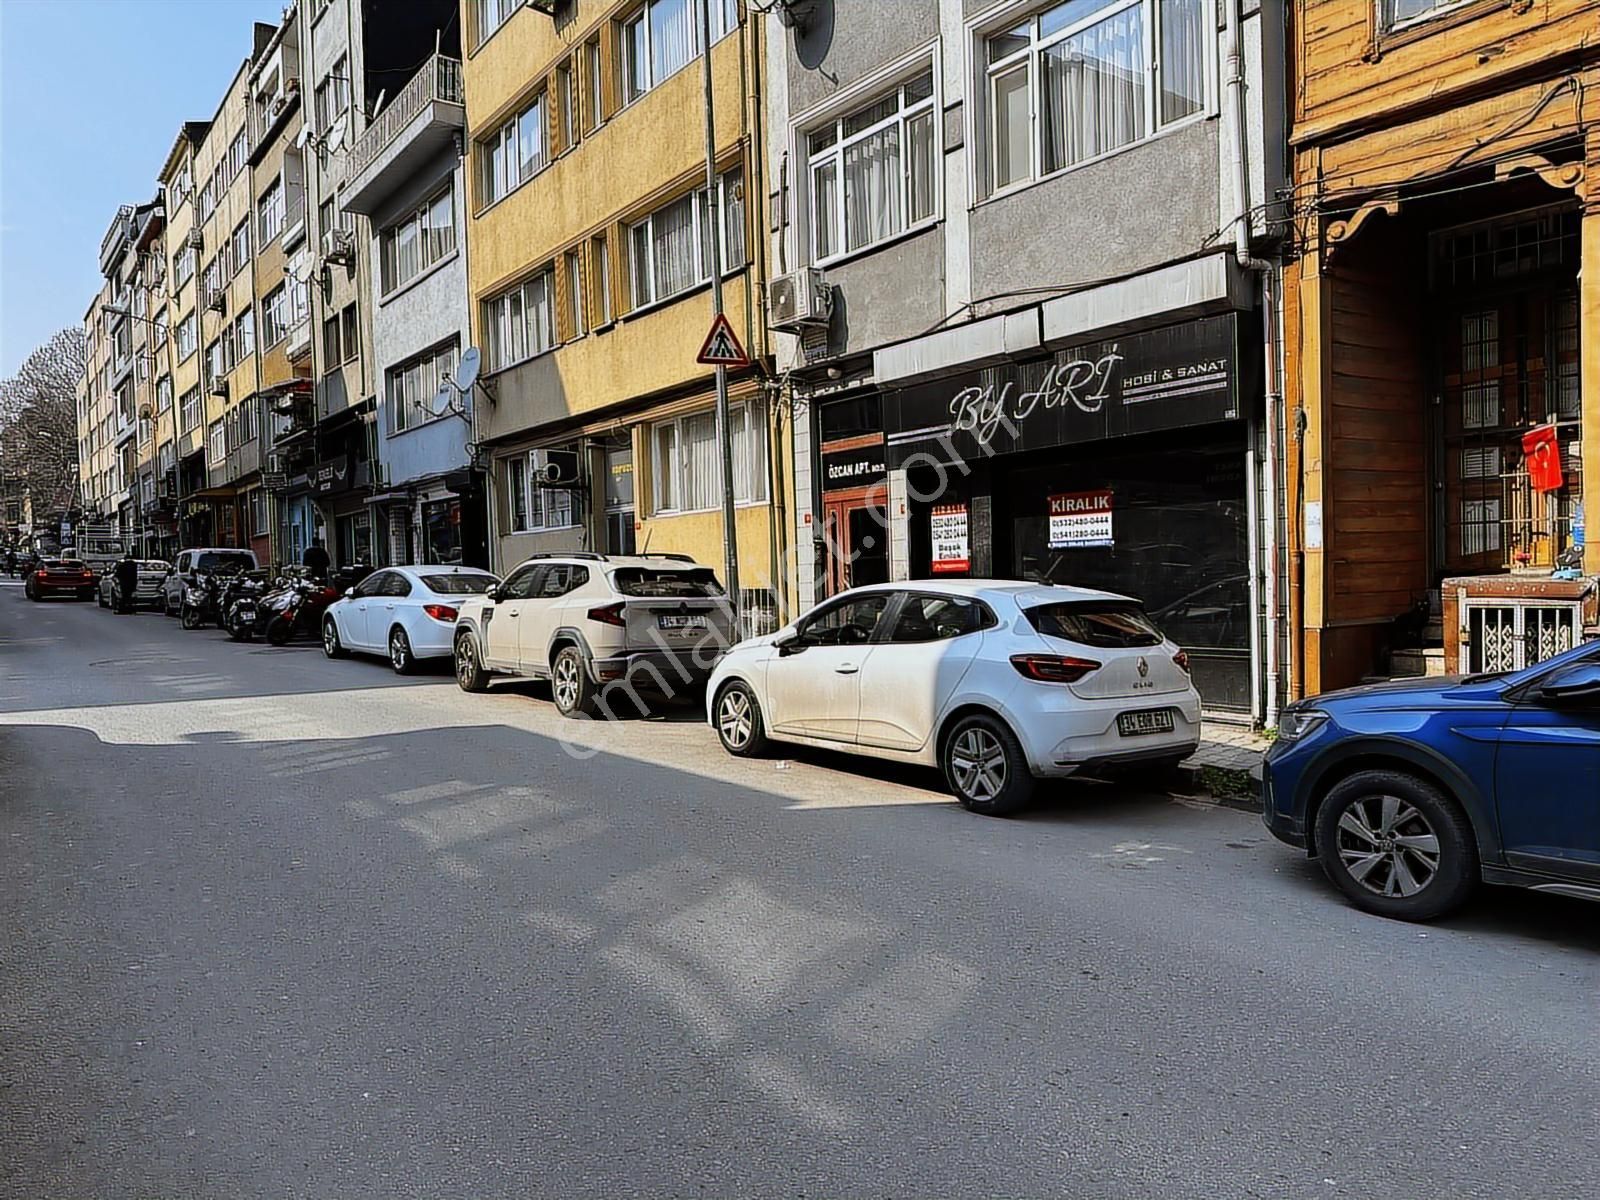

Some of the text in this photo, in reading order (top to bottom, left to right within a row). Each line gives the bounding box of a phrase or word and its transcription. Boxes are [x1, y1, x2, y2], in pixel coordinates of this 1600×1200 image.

[1123, 359, 1228, 388] HOBİ & SANAT
[950, 381, 1014, 444] BY
[828, 464, 854, 479] ÖZCAN
[1051, 495, 1110, 513] KİRALIK
